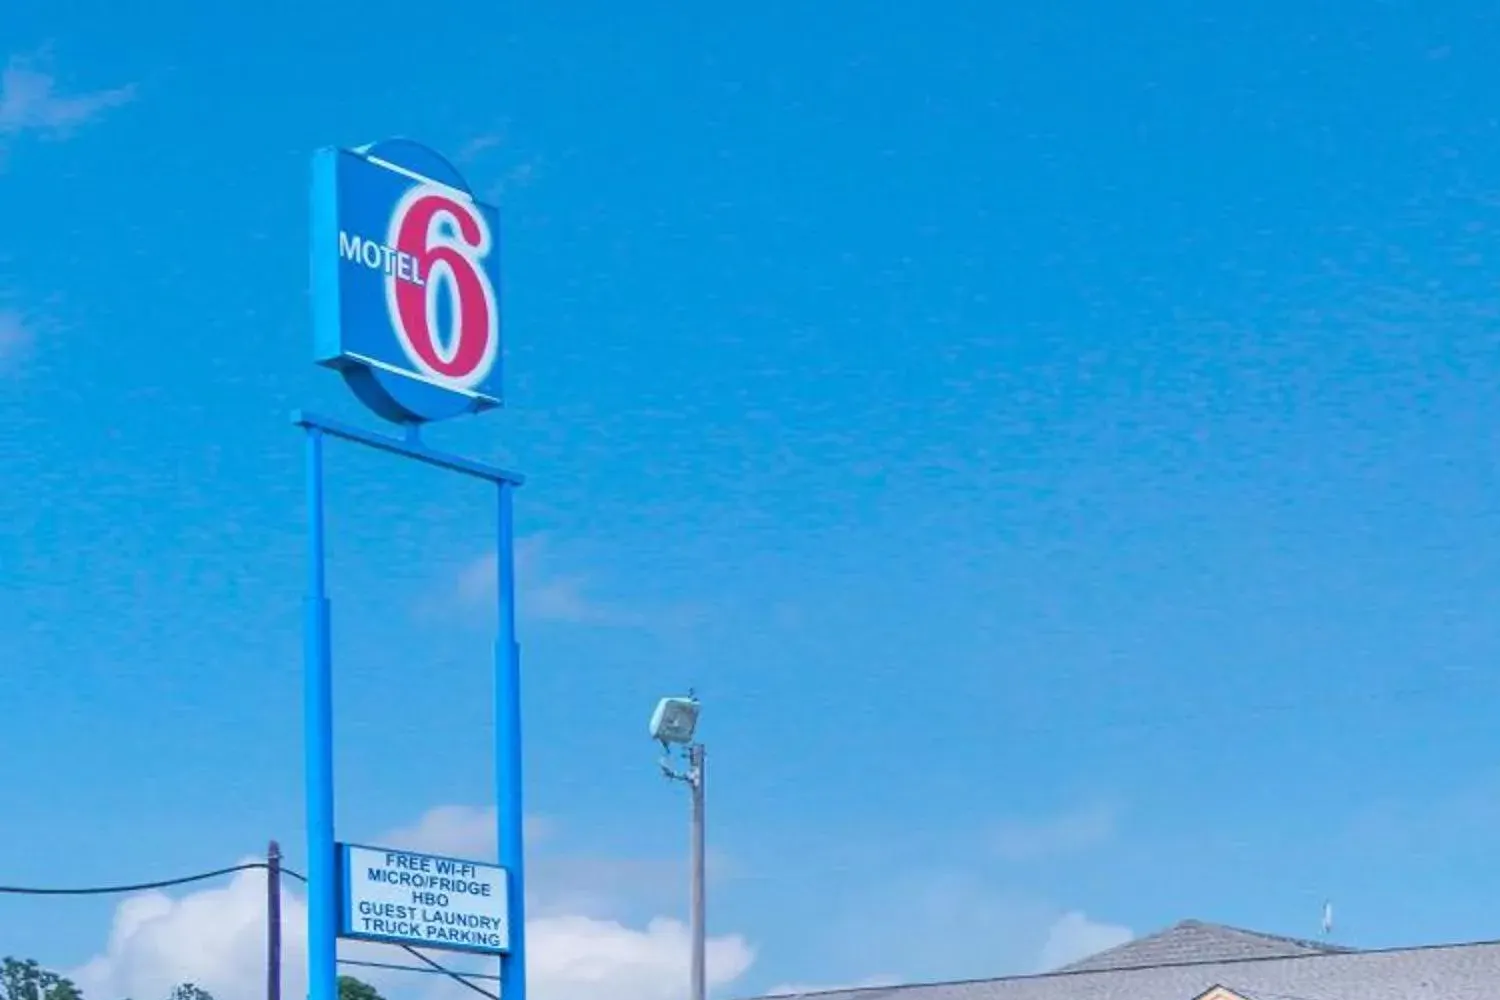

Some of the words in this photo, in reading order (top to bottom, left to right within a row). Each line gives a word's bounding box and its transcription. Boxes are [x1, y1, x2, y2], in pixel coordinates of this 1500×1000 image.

[339, 231, 424, 286] MOTEL
[386, 182, 499, 390] 6
[386, 854, 431, 873] FREE
[435, 860, 476, 879] WI-FI
[368, 867, 491, 897] MICRO/FRIDGE
[412, 891, 449, 907] HBO
[359, 901, 416, 920] GUEST
[422, 909, 502, 931] LAUNDRY
[362, 917, 421, 936] TRUCK
[425, 925, 501, 947] PARKING
